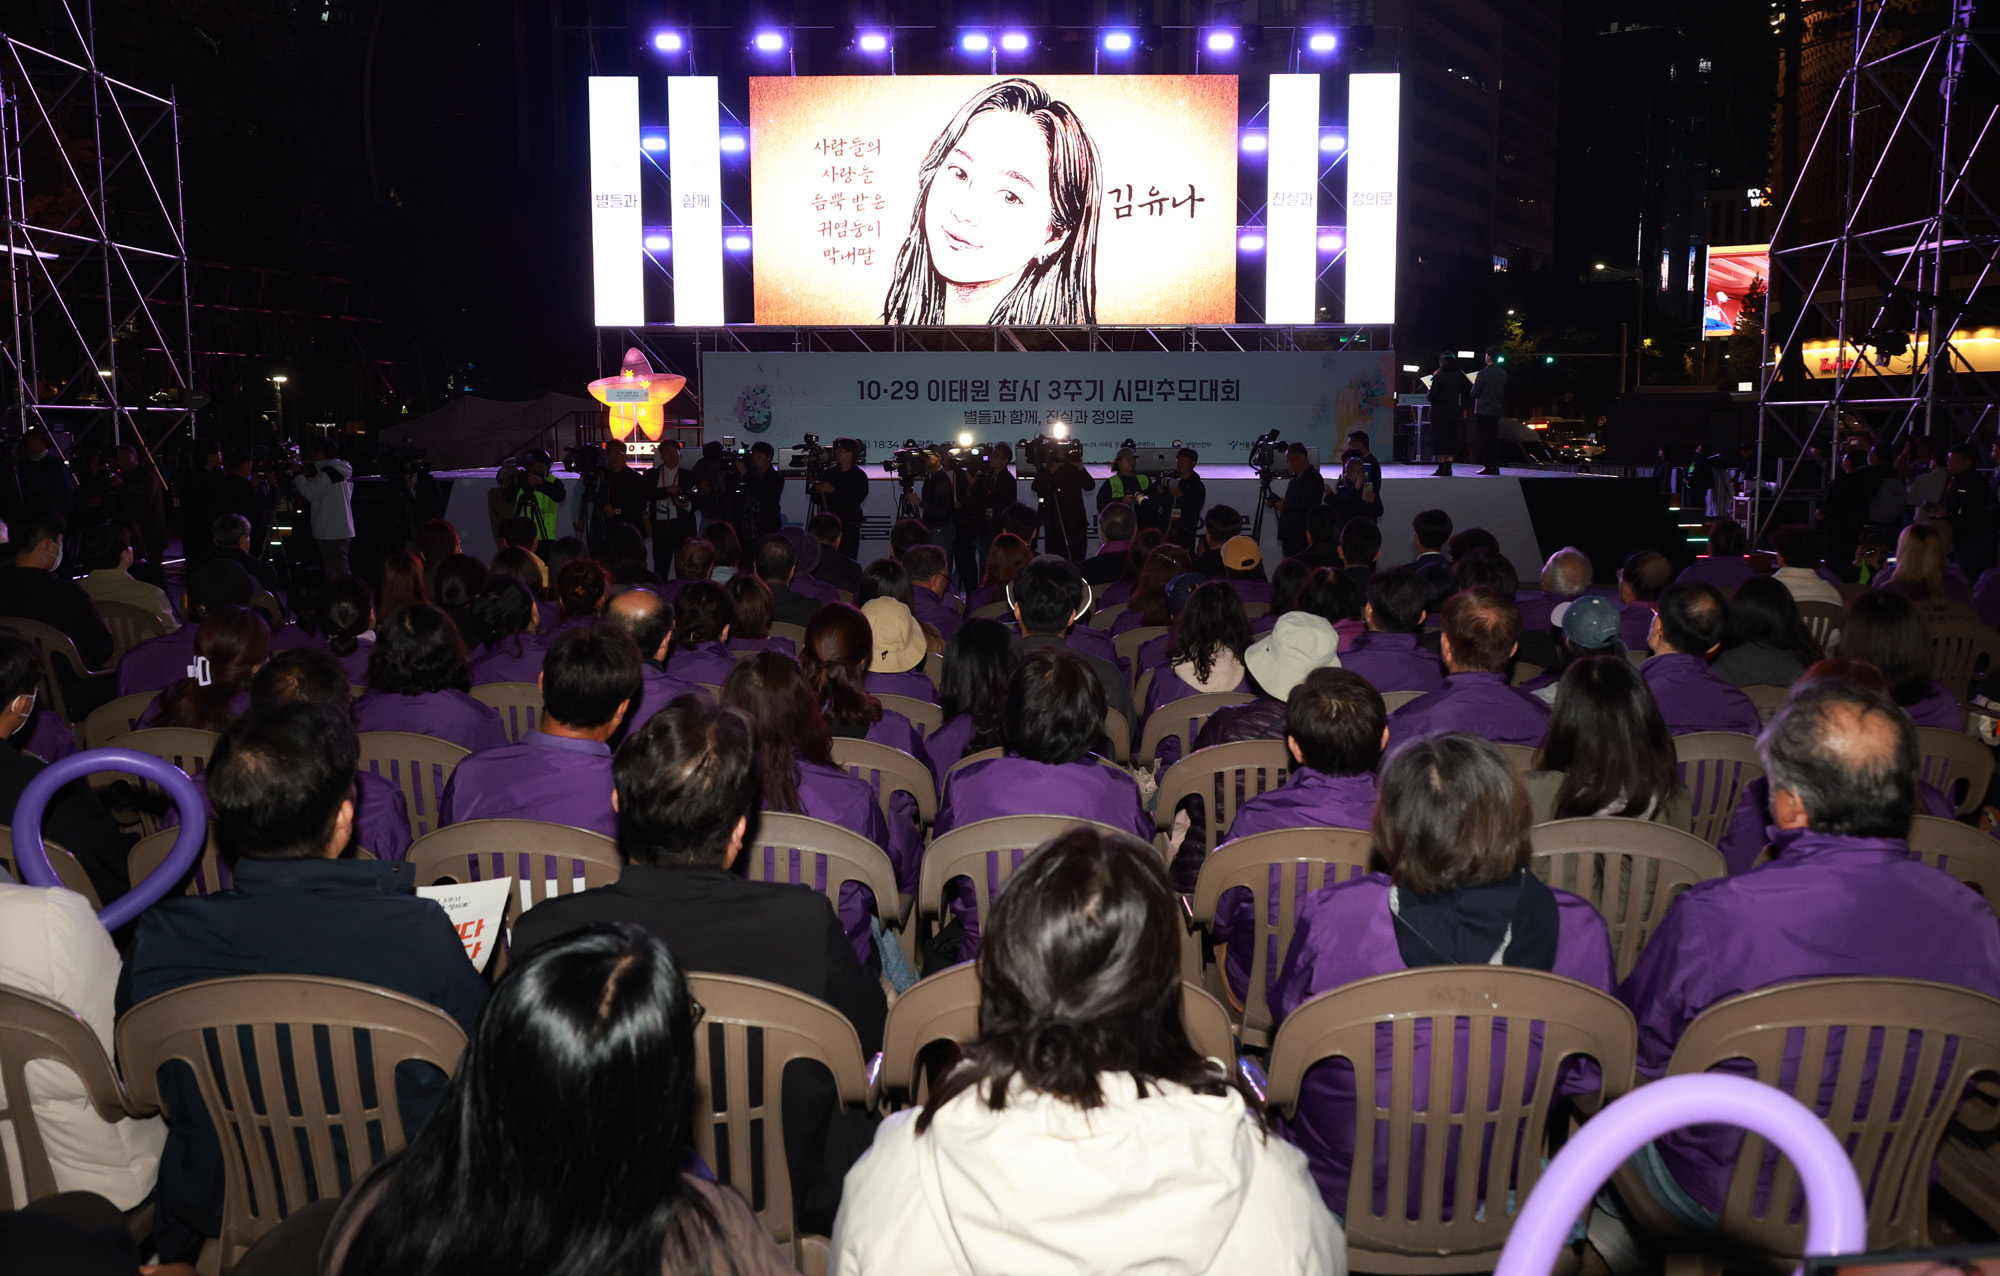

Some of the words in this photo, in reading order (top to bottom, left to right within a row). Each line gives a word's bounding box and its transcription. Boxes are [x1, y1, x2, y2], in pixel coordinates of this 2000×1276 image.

[812, 137, 881, 157] 사람들의
[822, 165, 874, 184] 사랑을
[596, 194, 637, 208] 별들과
[682, 194, 710, 208] 함께
[1108, 184, 1205, 219] 김유나
[1271, 191, 1313, 207] 진실과
[1352, 191, 1393, 206] 정의로
[817, 220, 881, 238] 귀염둥이
[823, 247, 875, 266] 막내딸
[927, 379, 990, 402] 이태원
[998, 378, 1041, 402] 참사
[1047, 379, 1104, 402] 3주기
[1112, 378, 1240, 402] 시민추모대회
[964, 410, 1006, 425] 별들과
[1010, 410, 1042, 426] 함께,
[1045, 410, 1088, 425] 진실과
[1091, 410, 1134, 425] 정의로
[873, 440, 900, 449] 18:34
